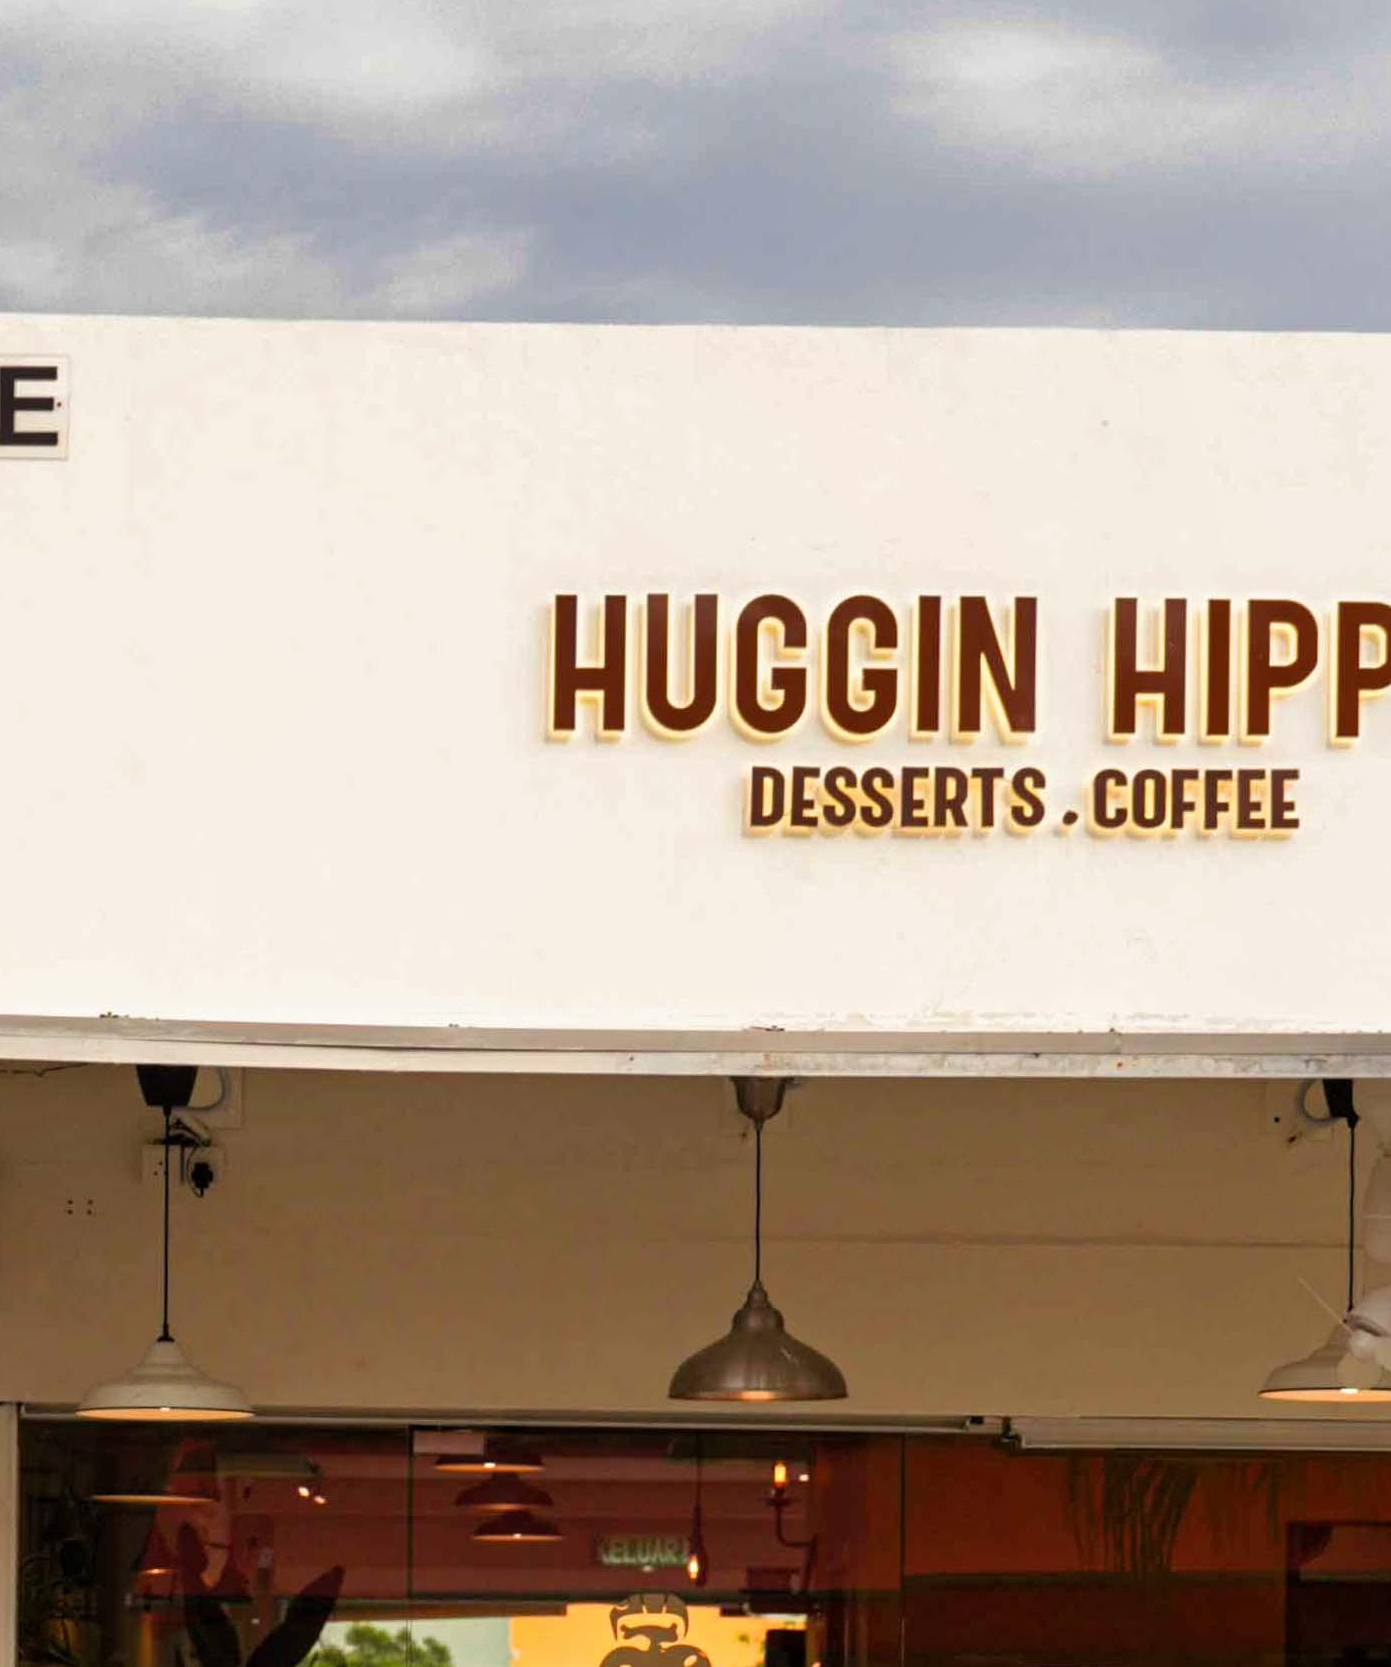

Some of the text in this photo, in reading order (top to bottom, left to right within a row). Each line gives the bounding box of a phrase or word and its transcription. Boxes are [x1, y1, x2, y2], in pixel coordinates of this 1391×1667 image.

[552, 592, 1038, 735] HUGGIN
[749, 765, 1047, 829] DESSERTS
[1092, 768, 1301, 830] COFFEE
